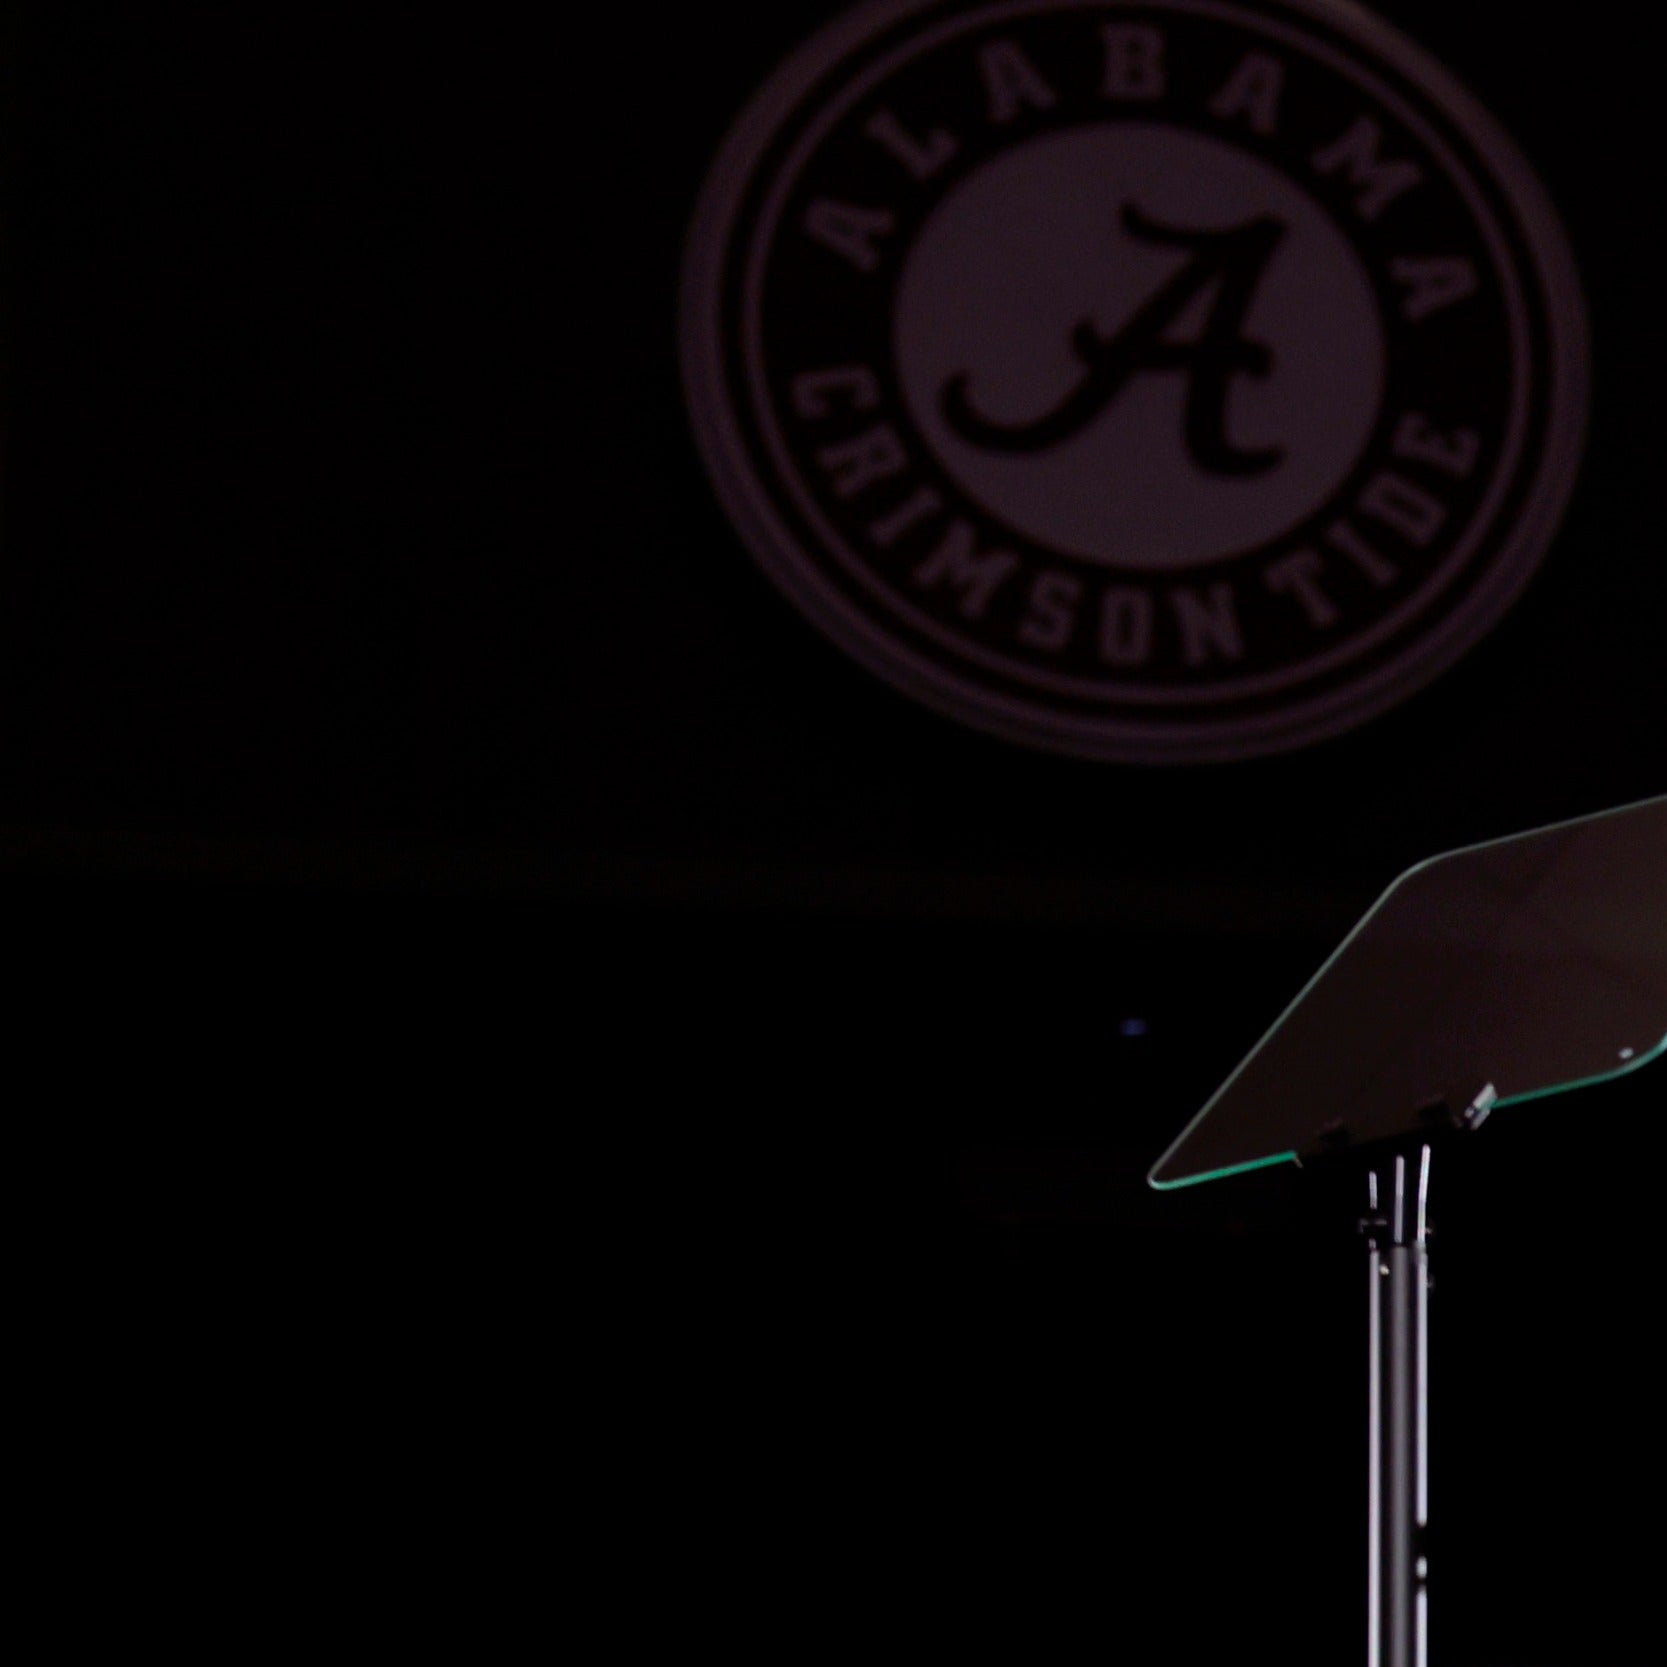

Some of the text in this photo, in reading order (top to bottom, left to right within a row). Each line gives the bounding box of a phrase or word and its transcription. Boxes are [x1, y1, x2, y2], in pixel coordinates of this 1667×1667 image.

[799, 19, 1482, 325] ALABAMA
[940, 196, 1287, 476] A
[797, 359, 1483, 668] CRIMSON TIDE
